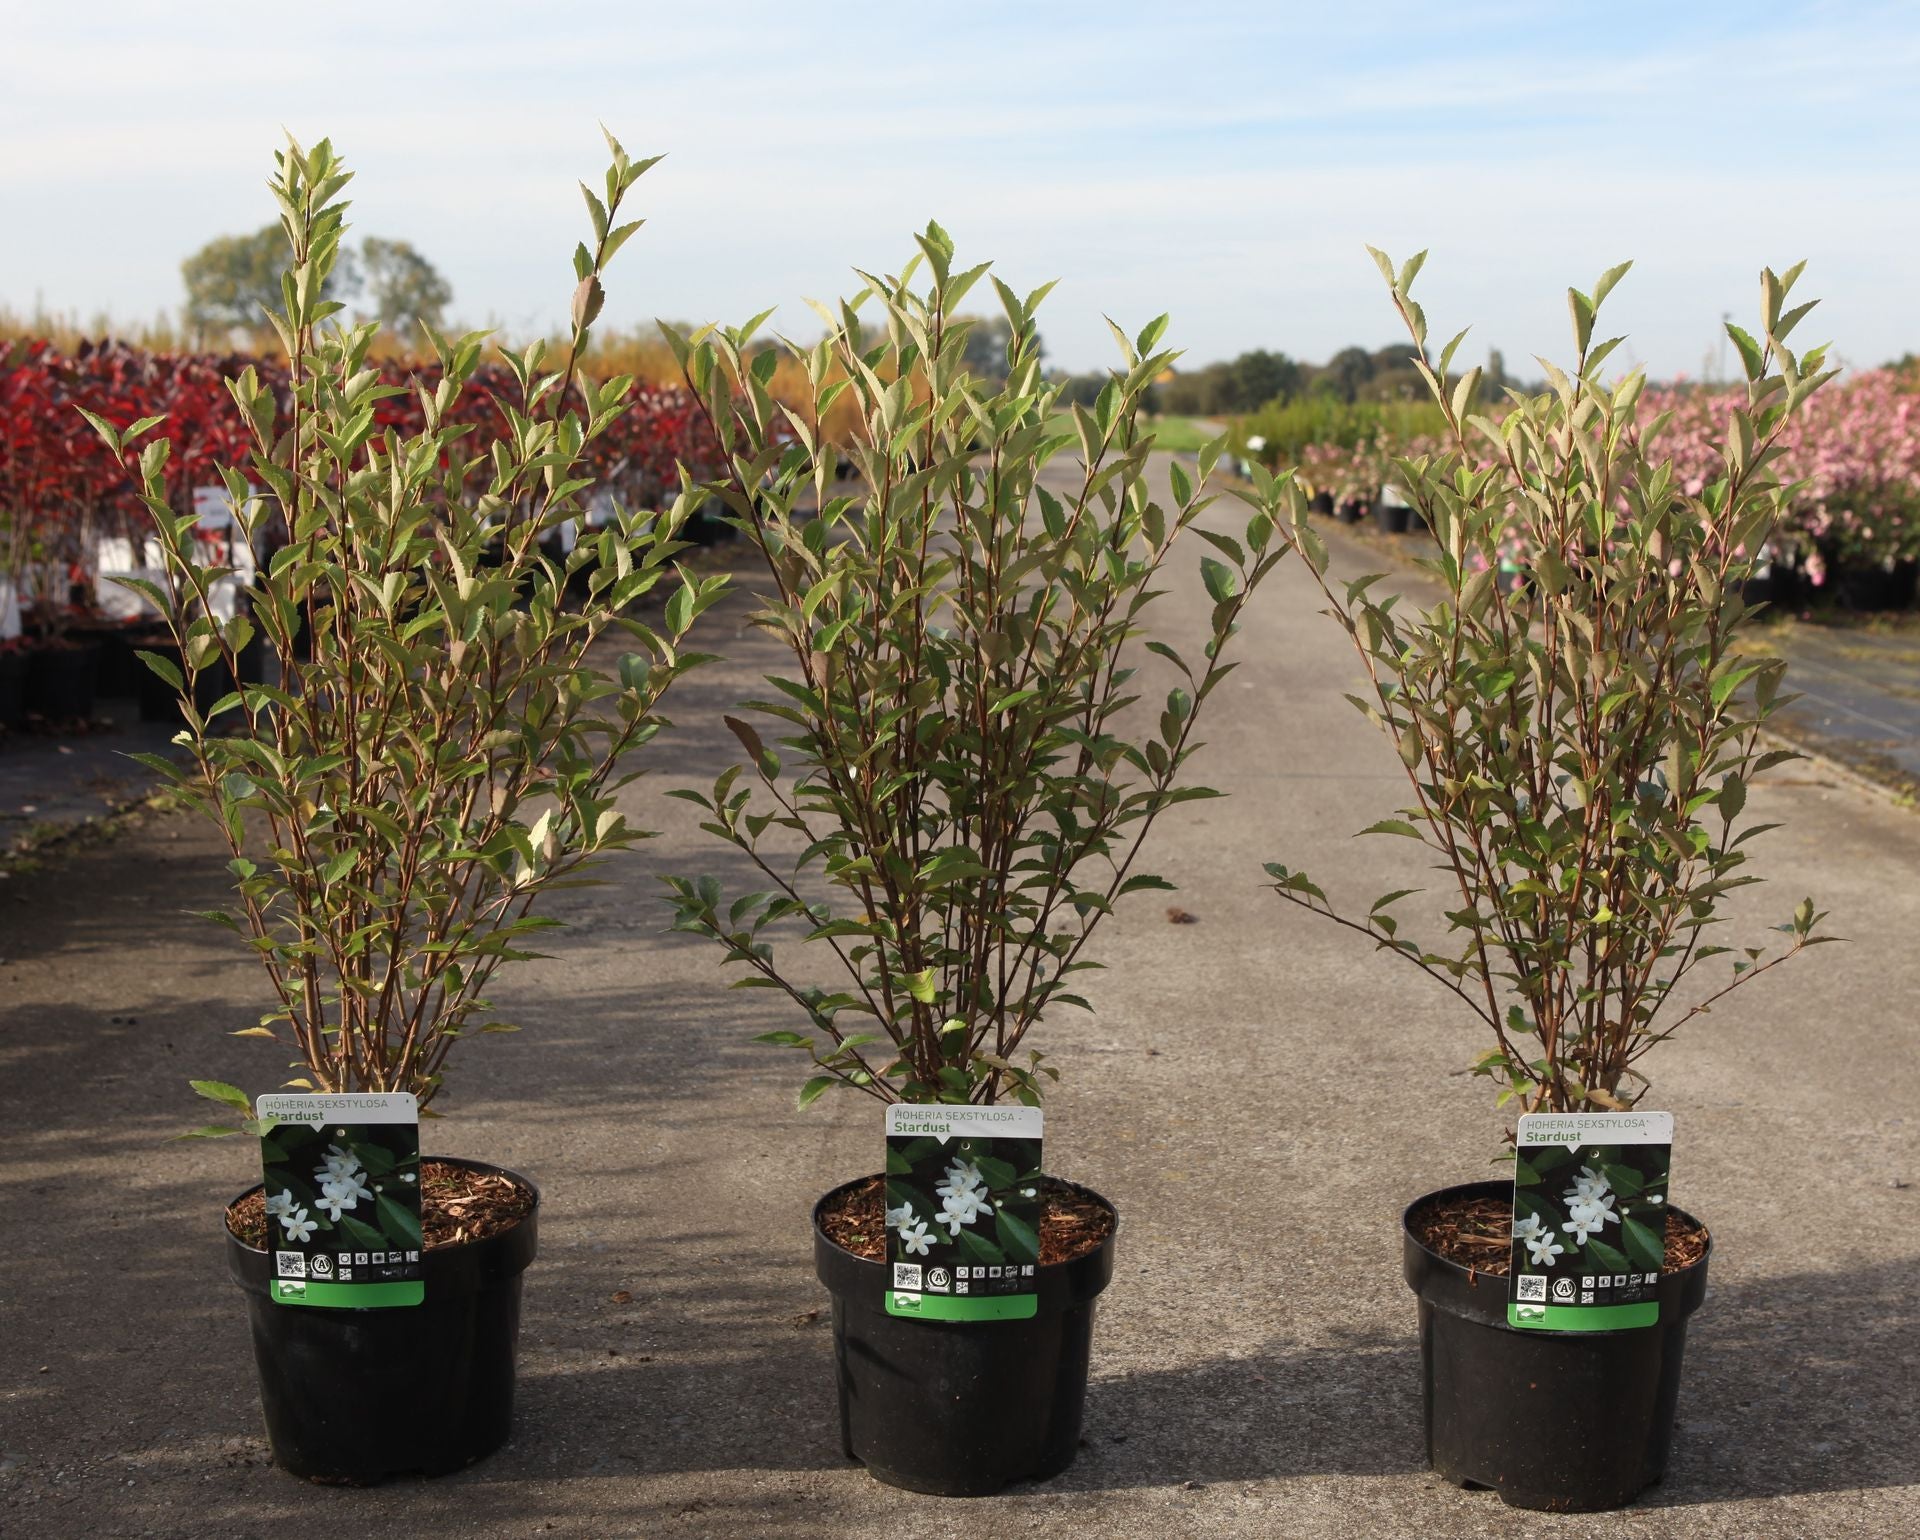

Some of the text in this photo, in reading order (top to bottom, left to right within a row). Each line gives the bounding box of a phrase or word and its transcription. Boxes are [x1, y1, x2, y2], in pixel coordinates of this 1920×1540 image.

[265, 1099, 388, 1110] HOHERIA SEXSTYLOSA
[266, 1111, 324, 1121] Stardust
[895, 1110, 1015, 1122] HOHERIA SEXSTYLOSA
[894, 1122, 950, 1133] Stardust
[1527, 1118, 1646, 1130] HOHERIA SEXSTYLOSA
[1525, 1131, 1582, 1142] Stardust
